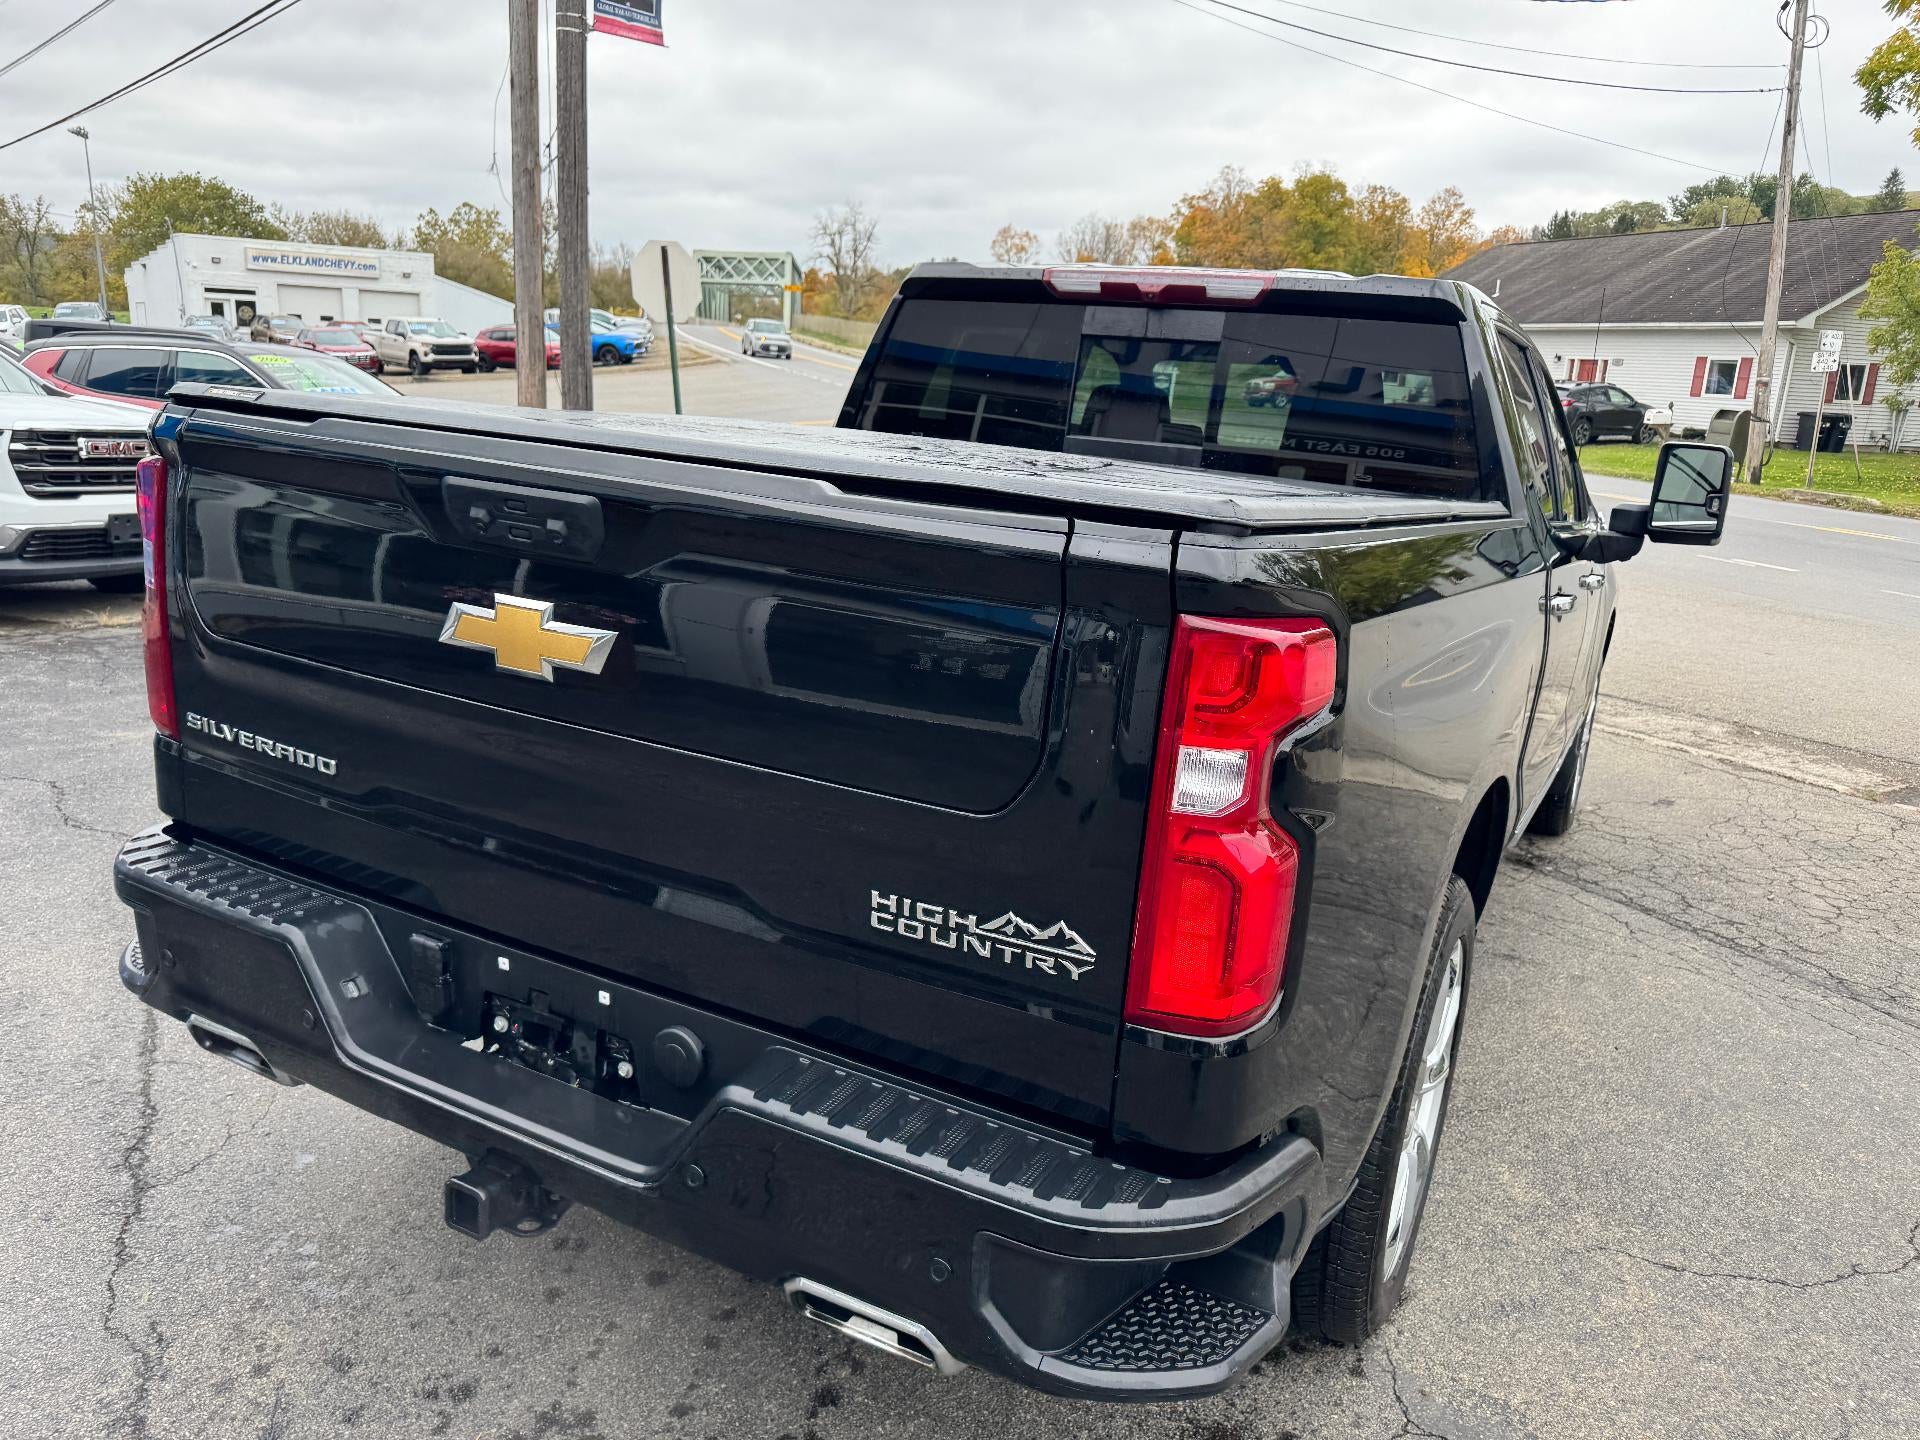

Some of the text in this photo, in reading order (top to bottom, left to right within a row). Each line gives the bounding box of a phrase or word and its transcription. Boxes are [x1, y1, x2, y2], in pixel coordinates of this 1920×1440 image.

[252, 254, 377, 271] www.ELKLANDCHEVY.com
[88, 441, 149, 455] GMC
[186, 711, 338, 776] SILVERADO
[871, 890, 977, 934] HIGH
[871, 910, 1094, 981] COUNTRY
